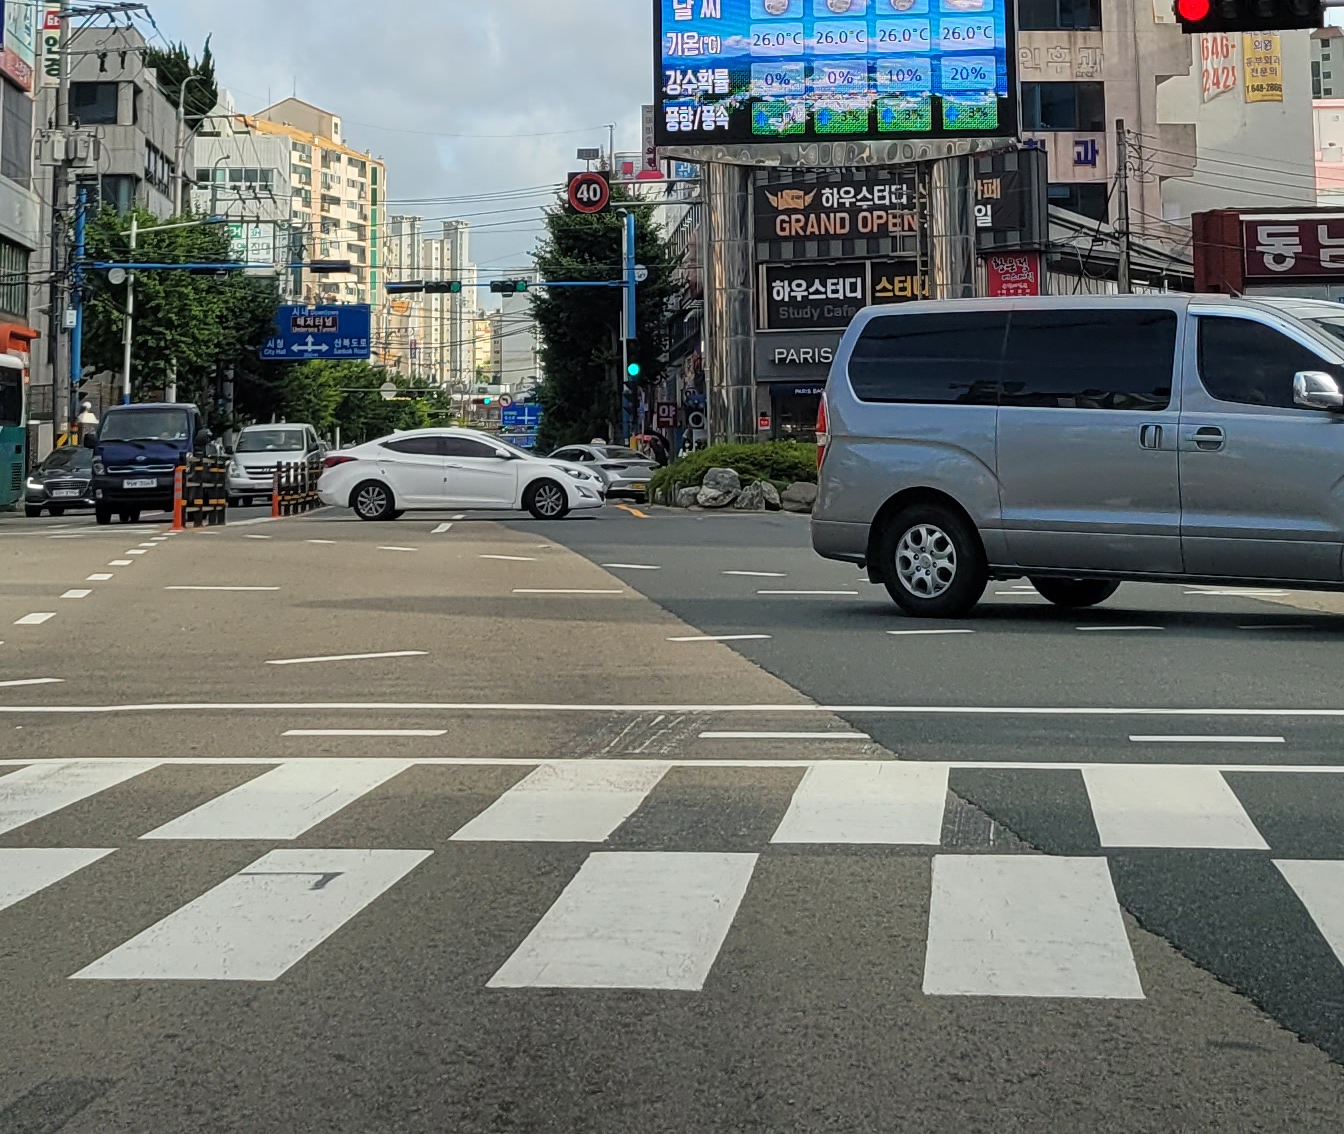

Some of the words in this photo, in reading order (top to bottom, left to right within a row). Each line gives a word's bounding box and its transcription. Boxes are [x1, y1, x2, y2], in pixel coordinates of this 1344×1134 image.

[950, 67, 986, 81] 20%
[577, 184, 600, 201] 40
[775, 212, 850, 238] GRAND
[857, 210, 918, 233] OPEN
[772, 276, 862, 302] 하우스터디
[779, 304, 819, 321] Study
[823, 303, 855, 319] Cafe
[775, 348, 833, 364] PARIS
[659, 406, 675, 425] 약
